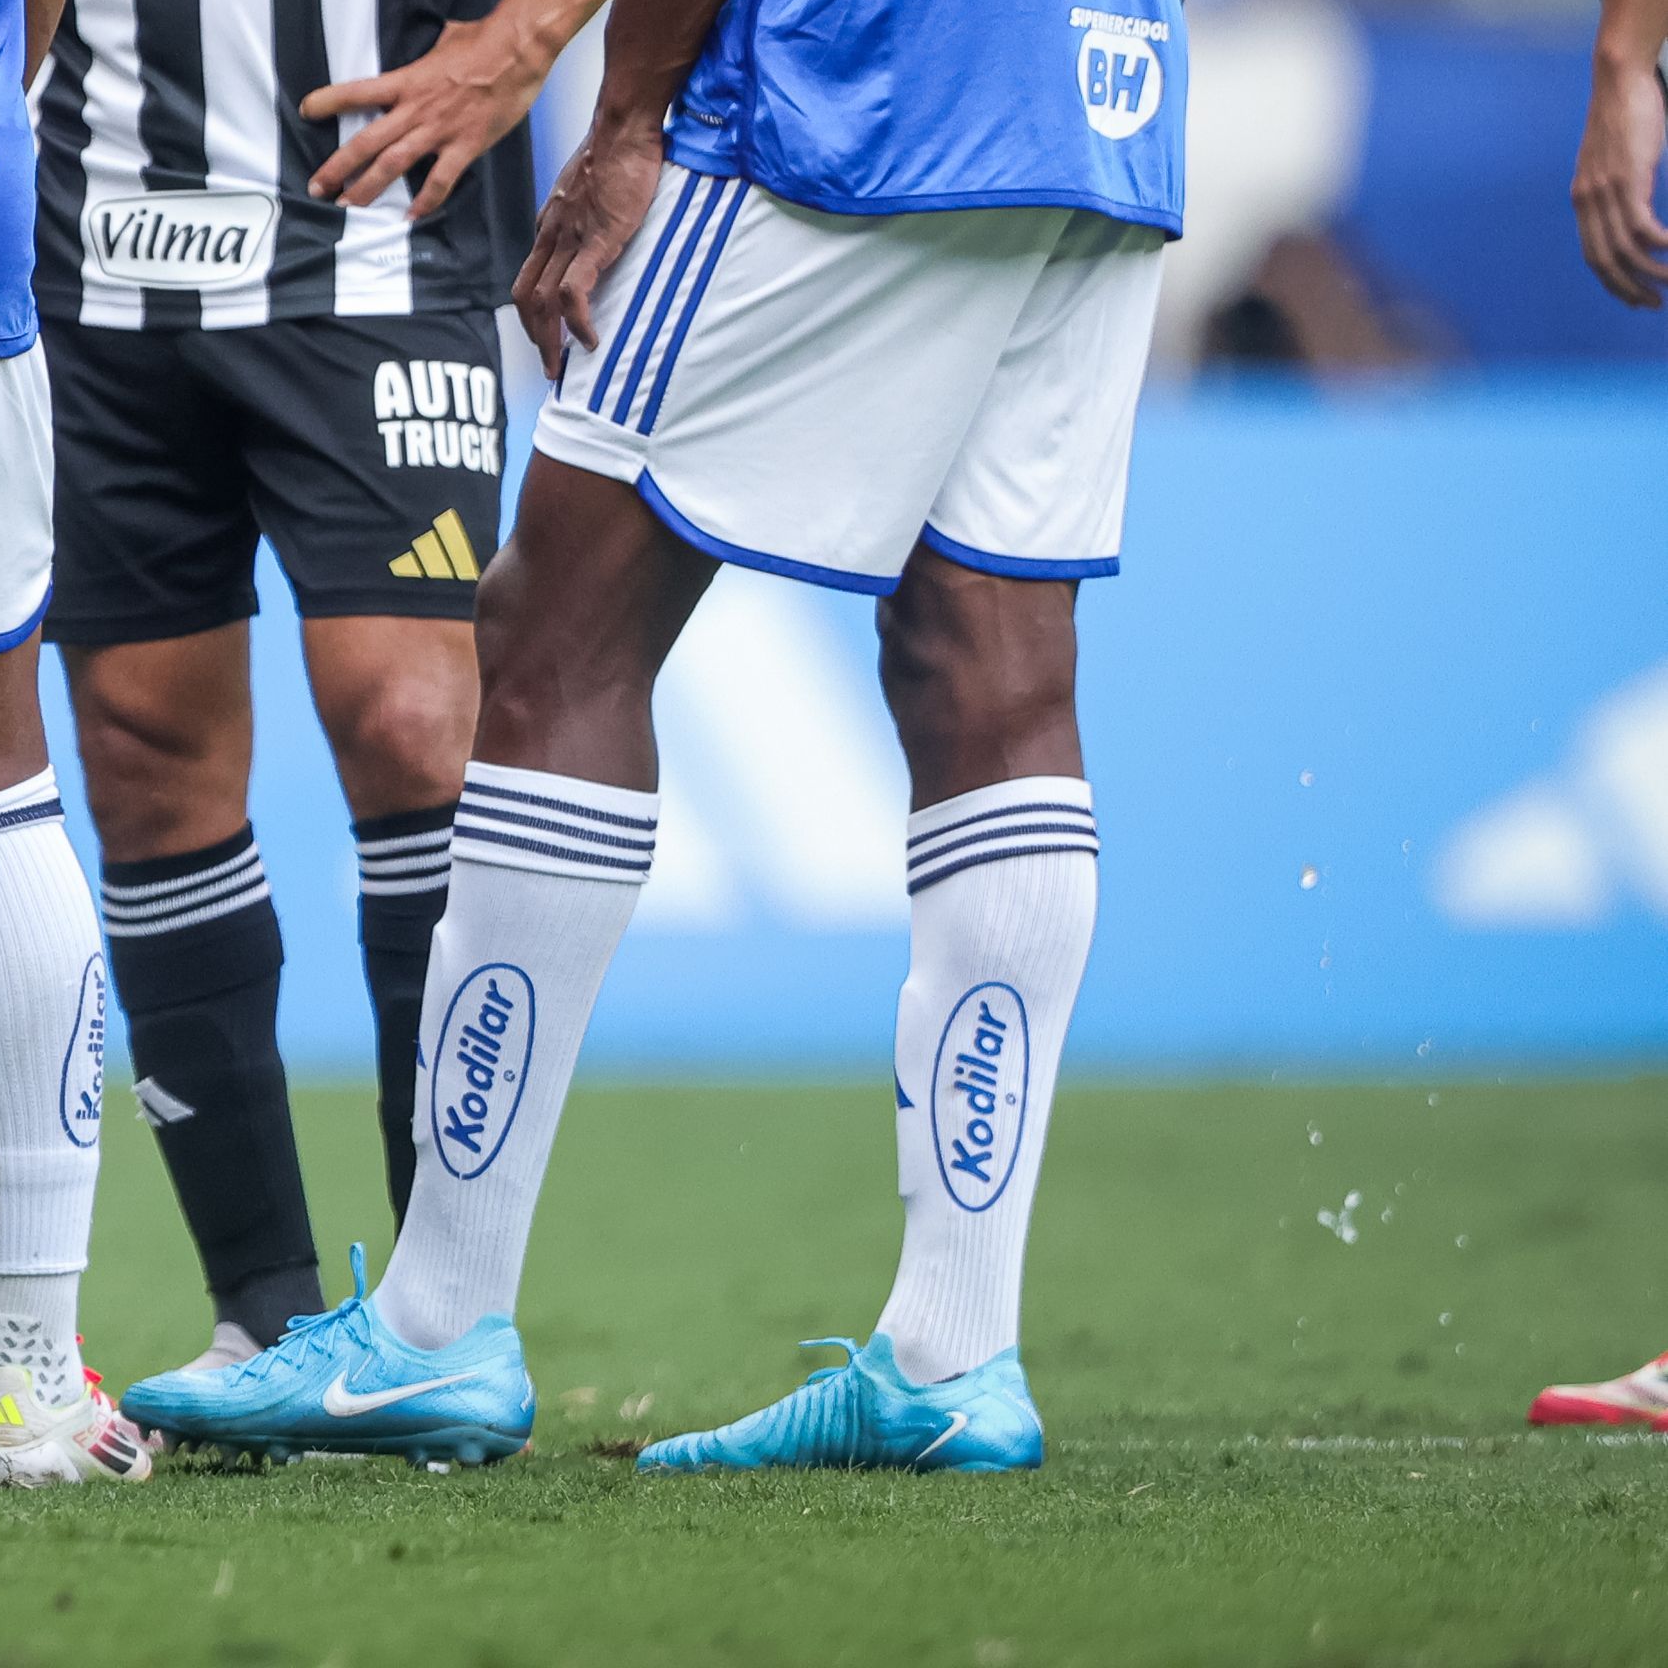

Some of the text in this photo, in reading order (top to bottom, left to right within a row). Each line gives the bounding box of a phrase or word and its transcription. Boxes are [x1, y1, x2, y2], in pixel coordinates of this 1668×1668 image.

[1088, 48, 1150, 114] BH
[101, 209, 249, 264] Vilma
[374, 360, 498, 426] AUTO
[378, 420, 501, 477] TRUCK
[444, 978, 514, 1154] Kodilar
[950, 1000, 1007, 1183] Kodilar
